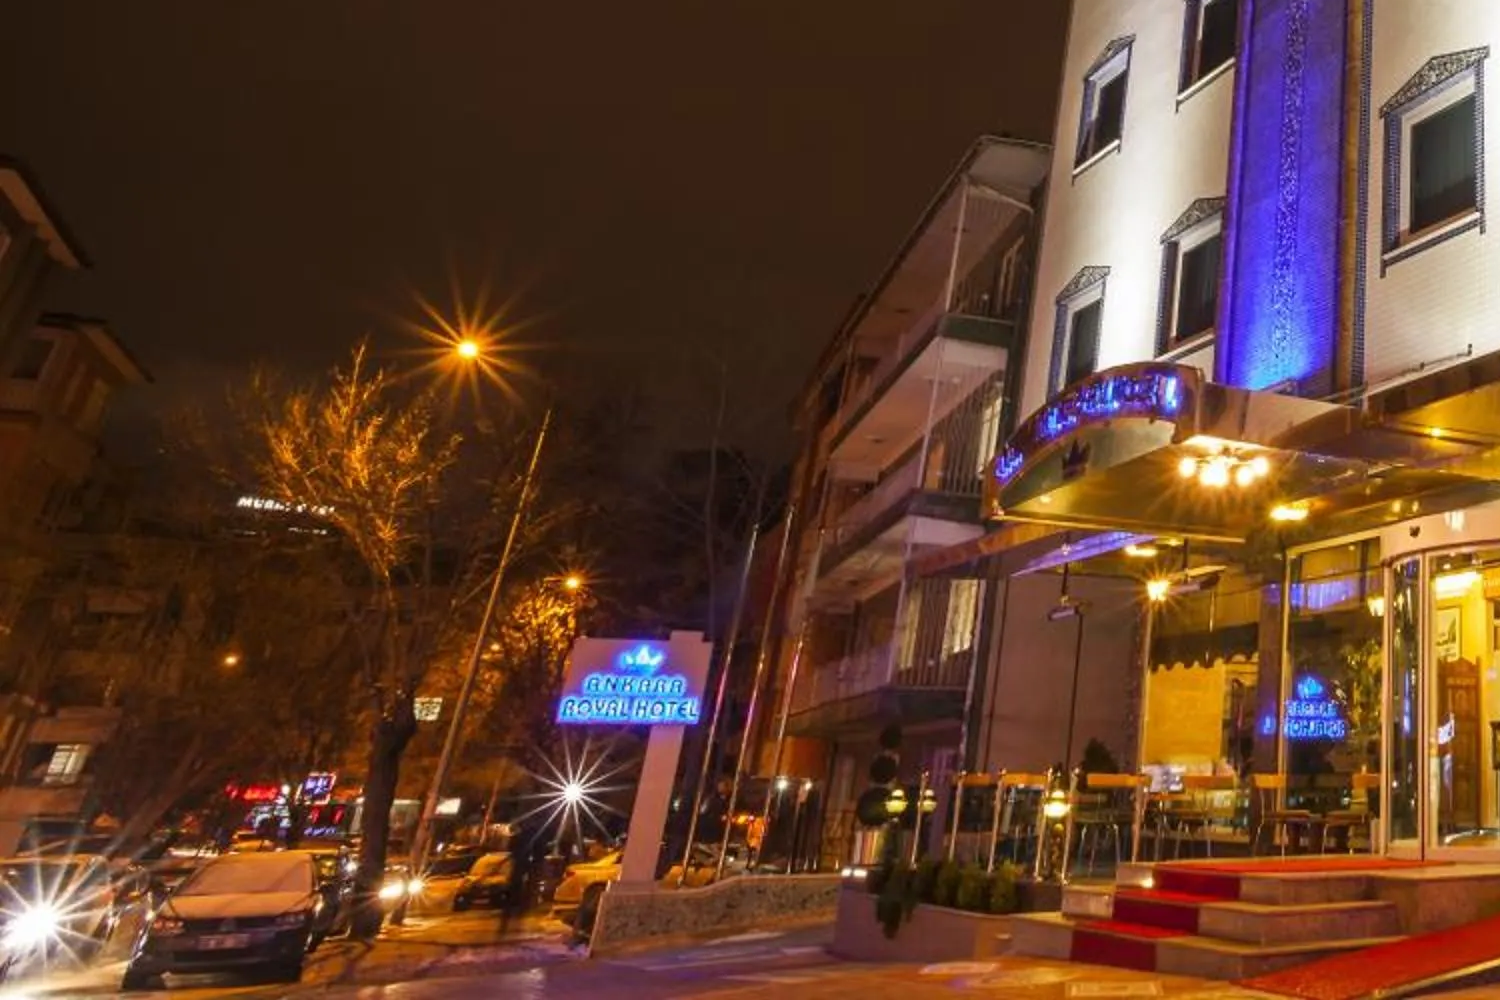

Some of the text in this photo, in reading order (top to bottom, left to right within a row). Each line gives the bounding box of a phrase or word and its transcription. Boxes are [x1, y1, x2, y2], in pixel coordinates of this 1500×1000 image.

[585, 676, 684, 694] ANKARA
[561, 698, 698, 719] ROYAL HOTEL
